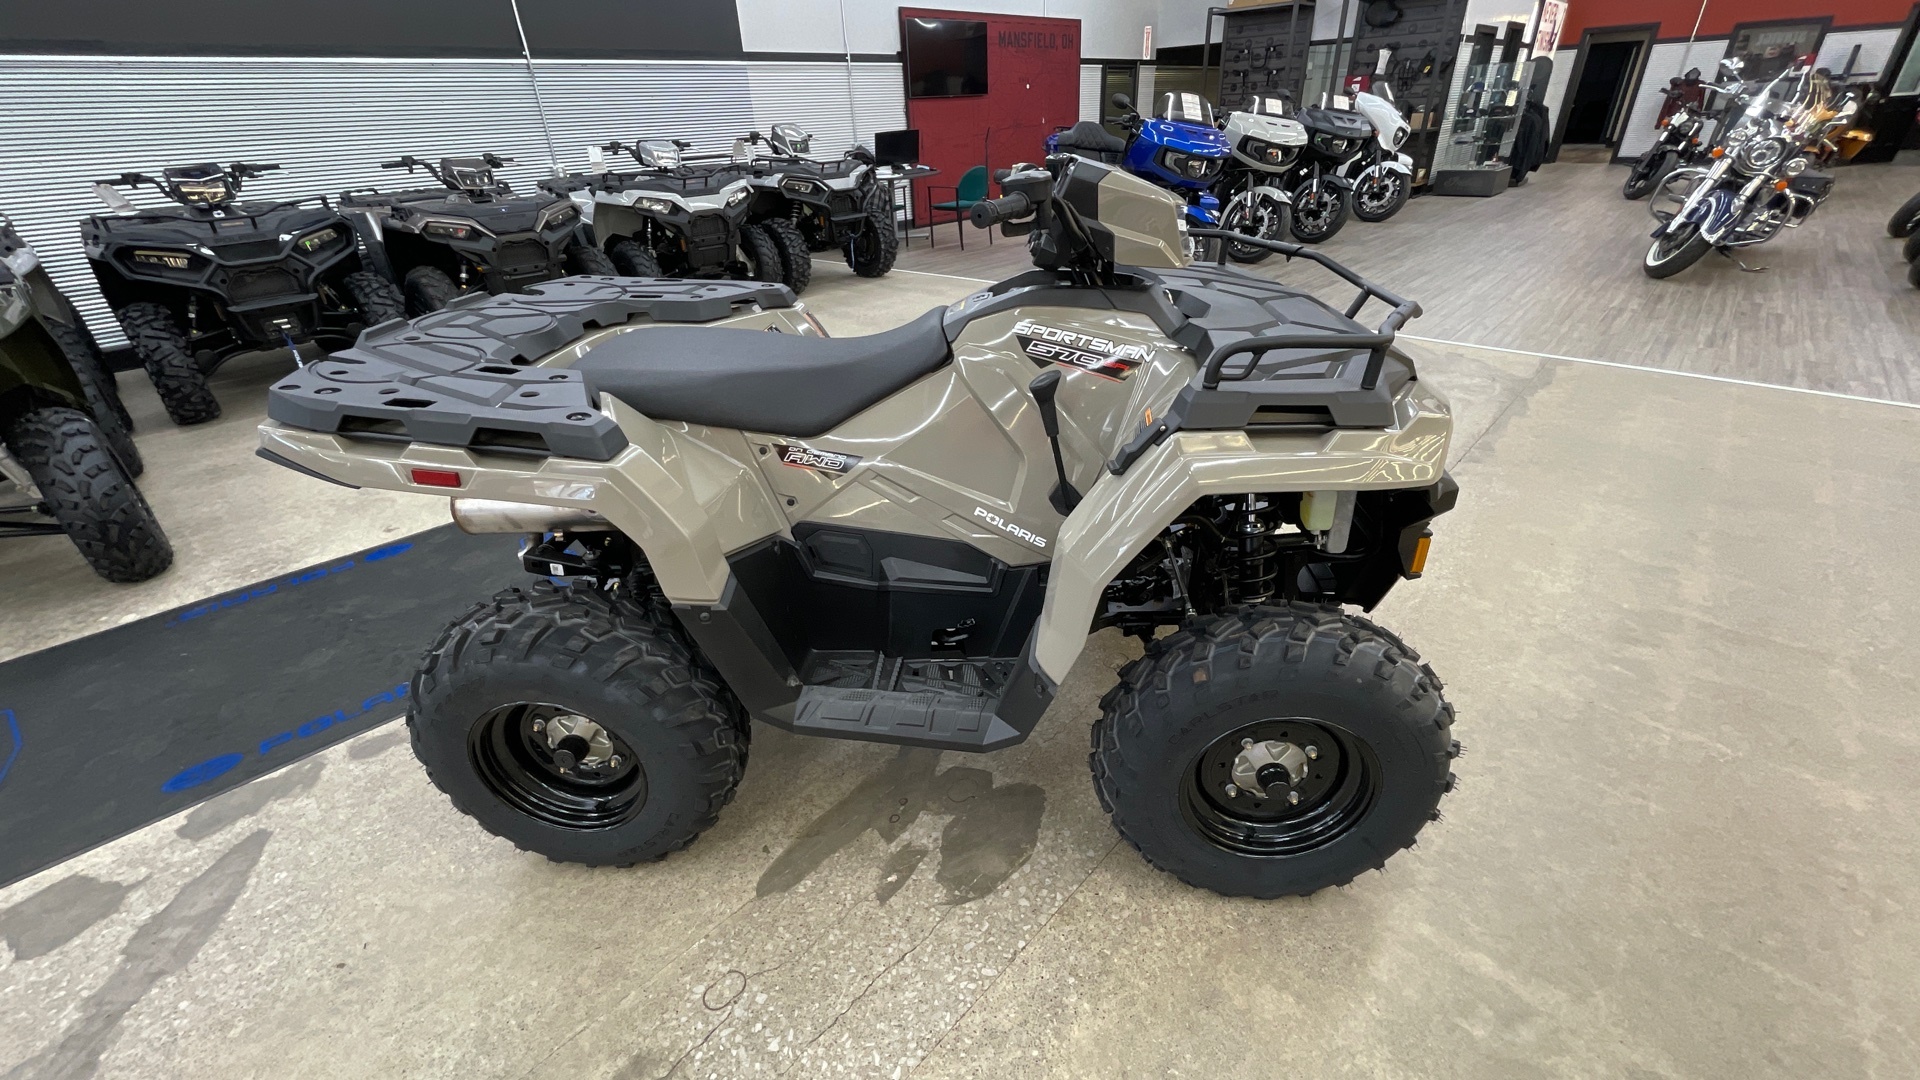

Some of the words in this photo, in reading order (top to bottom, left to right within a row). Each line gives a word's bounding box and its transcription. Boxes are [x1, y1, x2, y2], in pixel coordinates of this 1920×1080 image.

[998, 31, 1059, 51] MANSFIELD,
[1062, 33, 1075, 50] OH
[1012, 321, 1156, 363] SPORTSMAN
[1026, 340, 1104, 369] 570
[783, 451, 845, 470] AWD
[973, 506, 1047, 548] POLARIS
